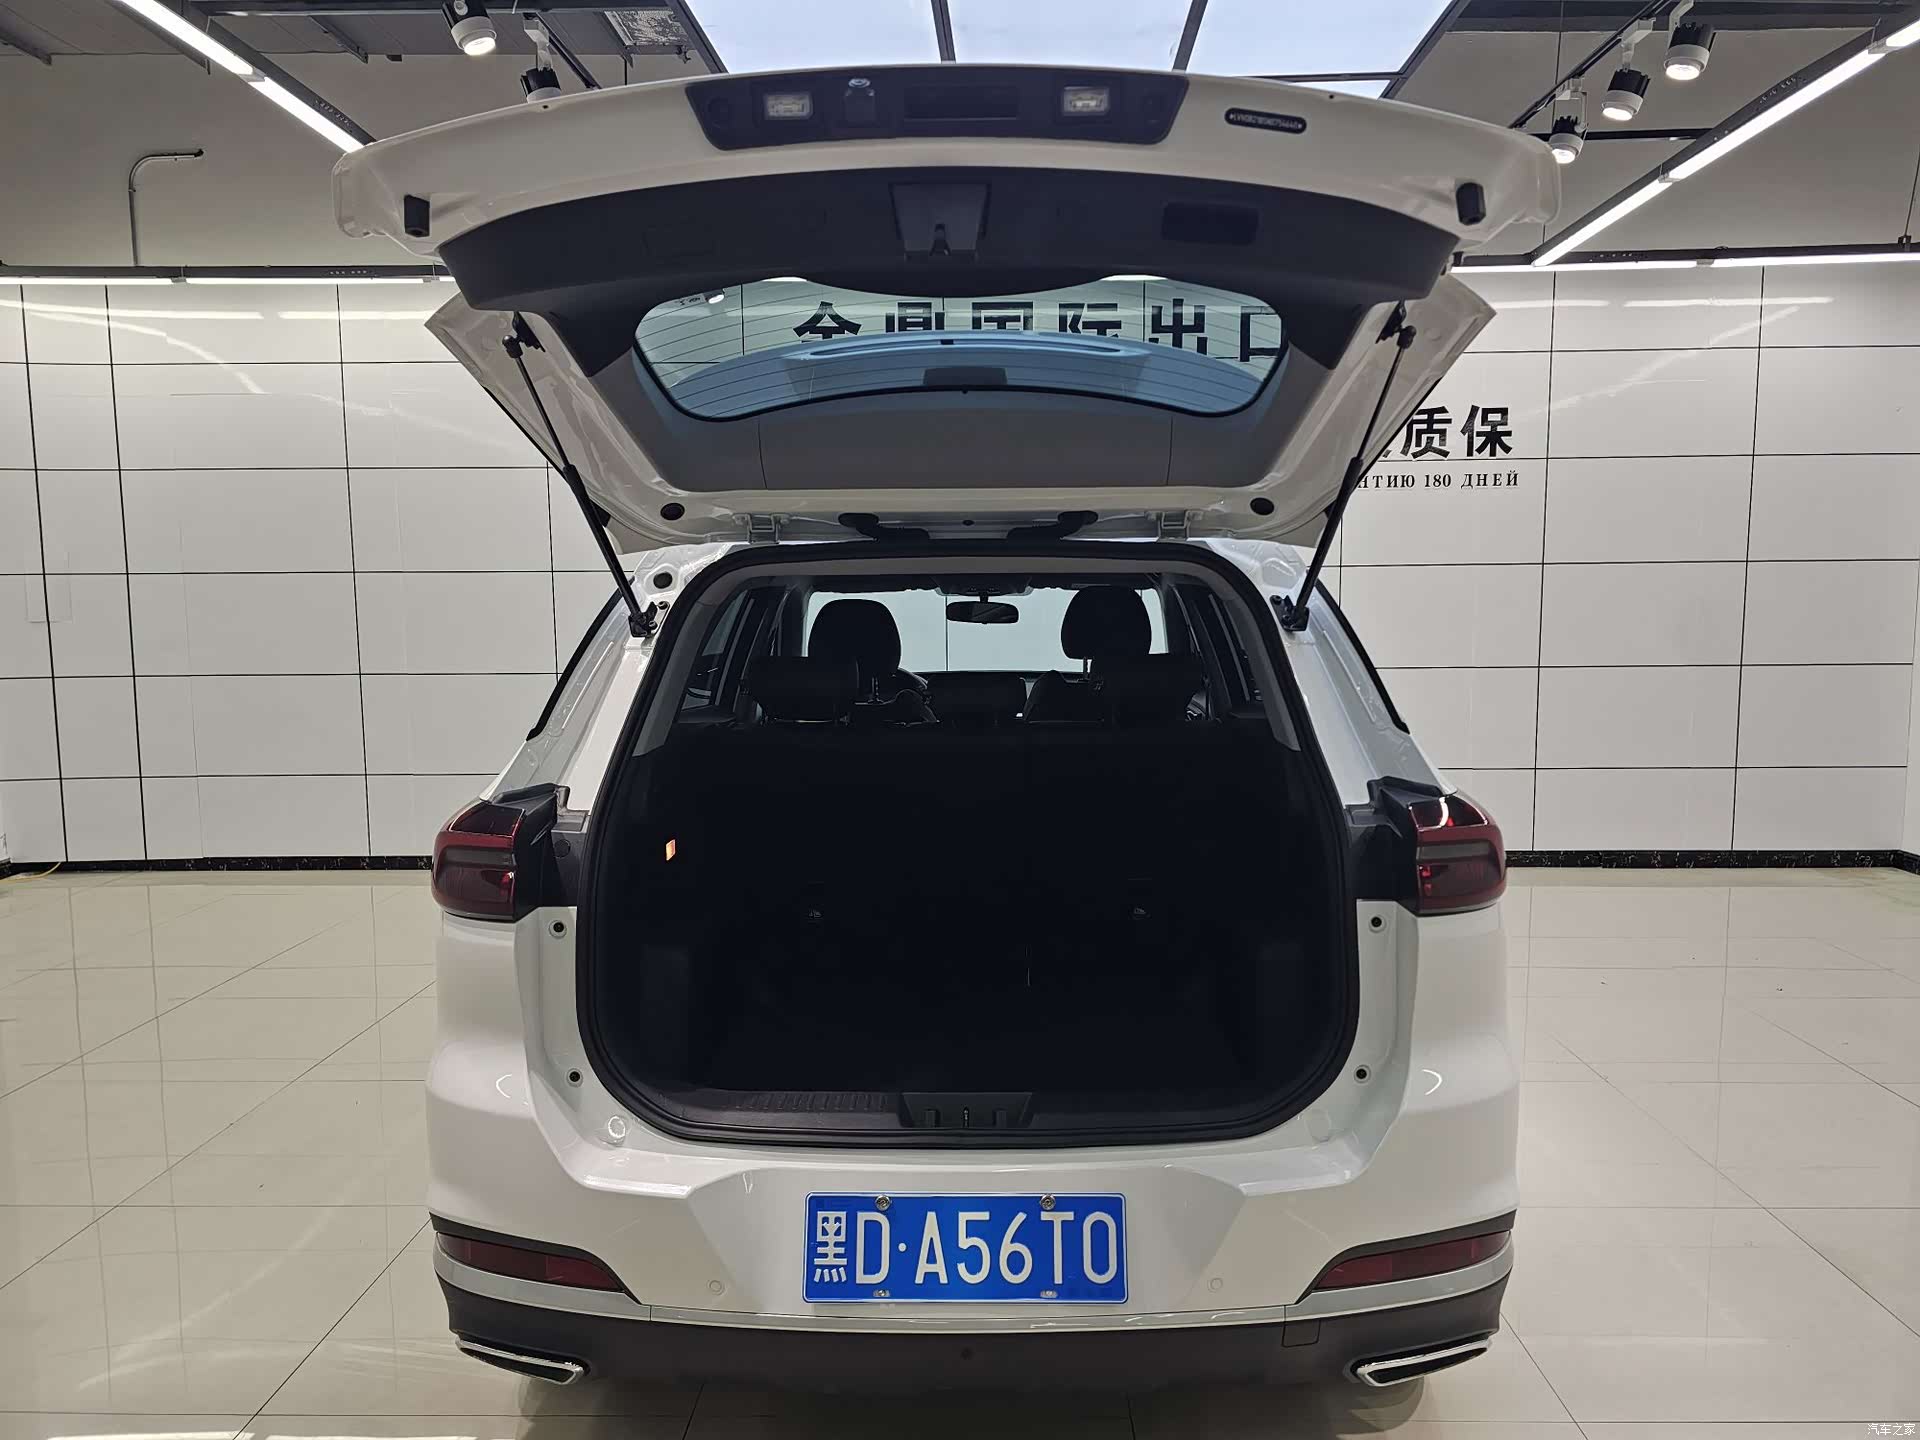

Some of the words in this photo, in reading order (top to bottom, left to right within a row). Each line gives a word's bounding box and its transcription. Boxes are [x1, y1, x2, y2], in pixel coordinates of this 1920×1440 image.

[1383, 405, 1513, 459] 质保
[1424, 474, 1452, 488] 180
[1460, 470, 1520, 489] ДНЕЙ
